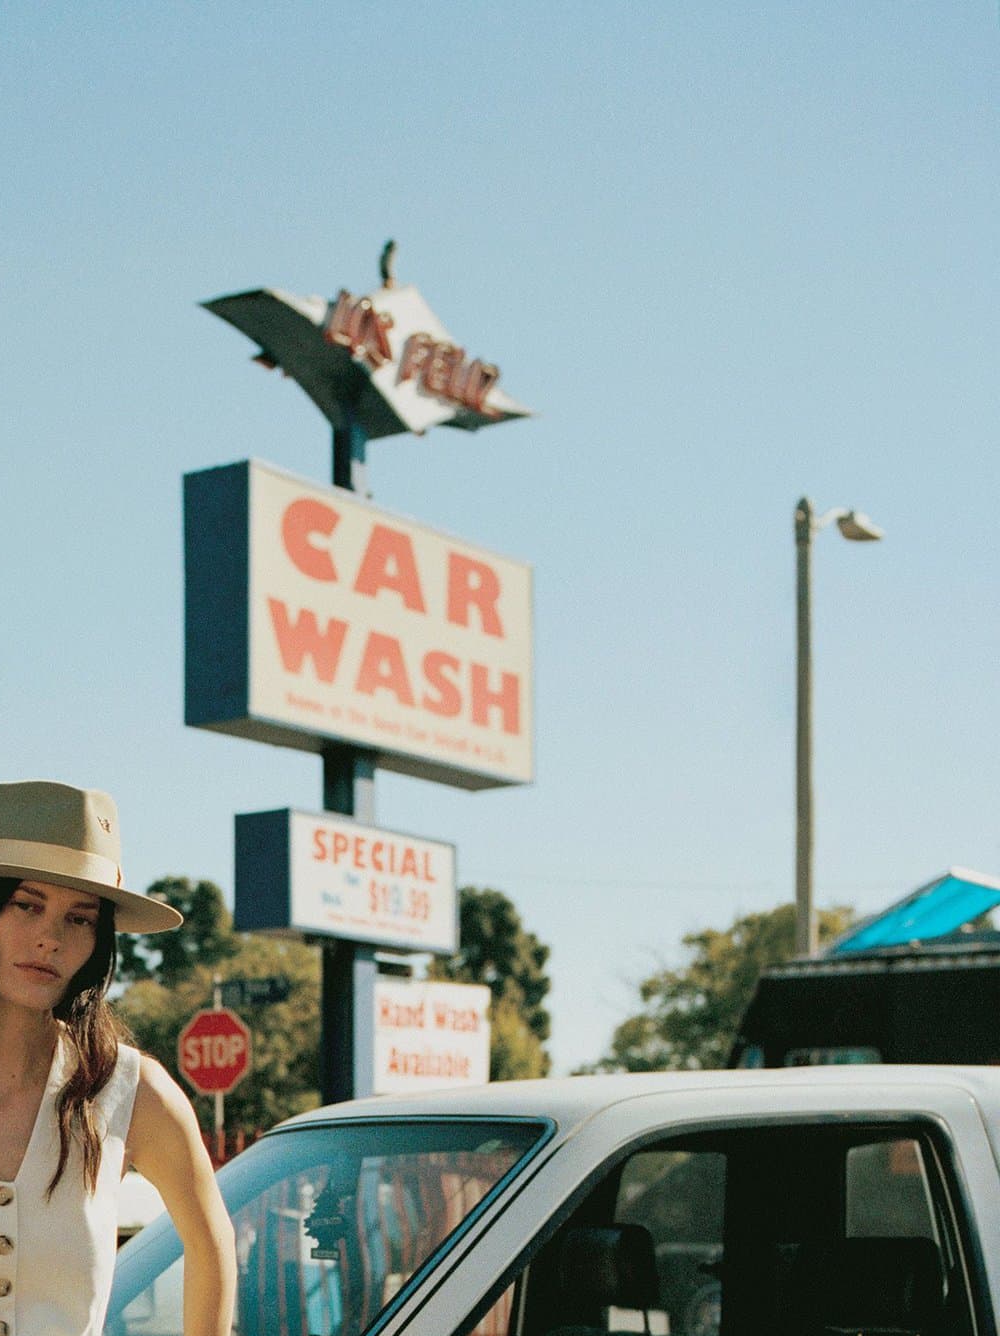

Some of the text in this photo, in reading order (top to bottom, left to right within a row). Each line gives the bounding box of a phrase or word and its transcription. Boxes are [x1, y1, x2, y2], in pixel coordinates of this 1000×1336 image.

[280, 496, 505, 640] CAR
[264, 593, 521, 737] WASH
[311, 827, 438, 883] SPECIAL
[378, 998, 480, 1033] Hand Wash
[183, 1035, 245, 1070] STOP
[387, 1045, 471, 1079] Available
